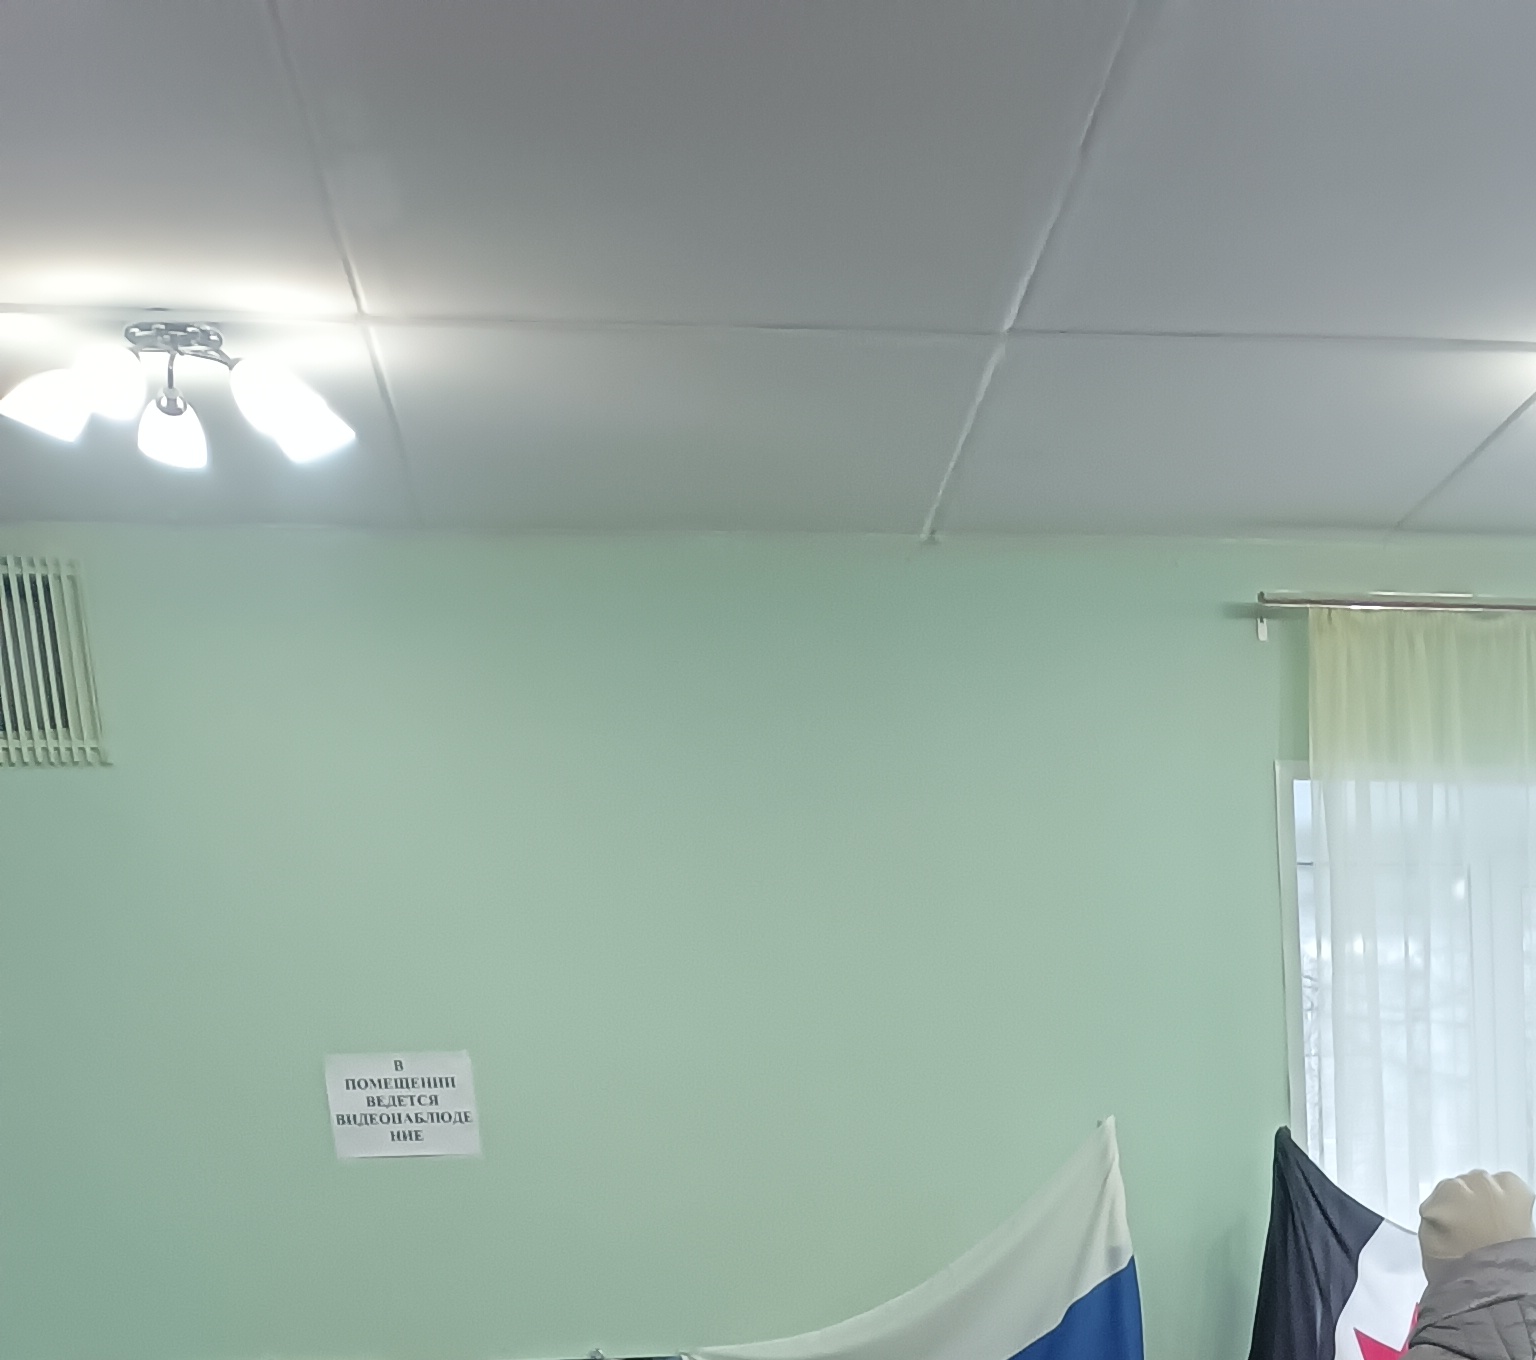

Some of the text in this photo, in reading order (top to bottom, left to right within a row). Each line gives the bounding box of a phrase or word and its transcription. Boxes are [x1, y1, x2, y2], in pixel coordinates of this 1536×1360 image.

[394, 1059, 404, 1072] В
[345, 1076, 456, 1091] ПОМЕЩЕНИИ
[366, 1094, 439, 1109] ВЕДЕТСЯ
[336, 1111, 473, 1127] ВИДЕОНАБЛЮДЕ
[390, 1129, 424, 1142] НИЕ
